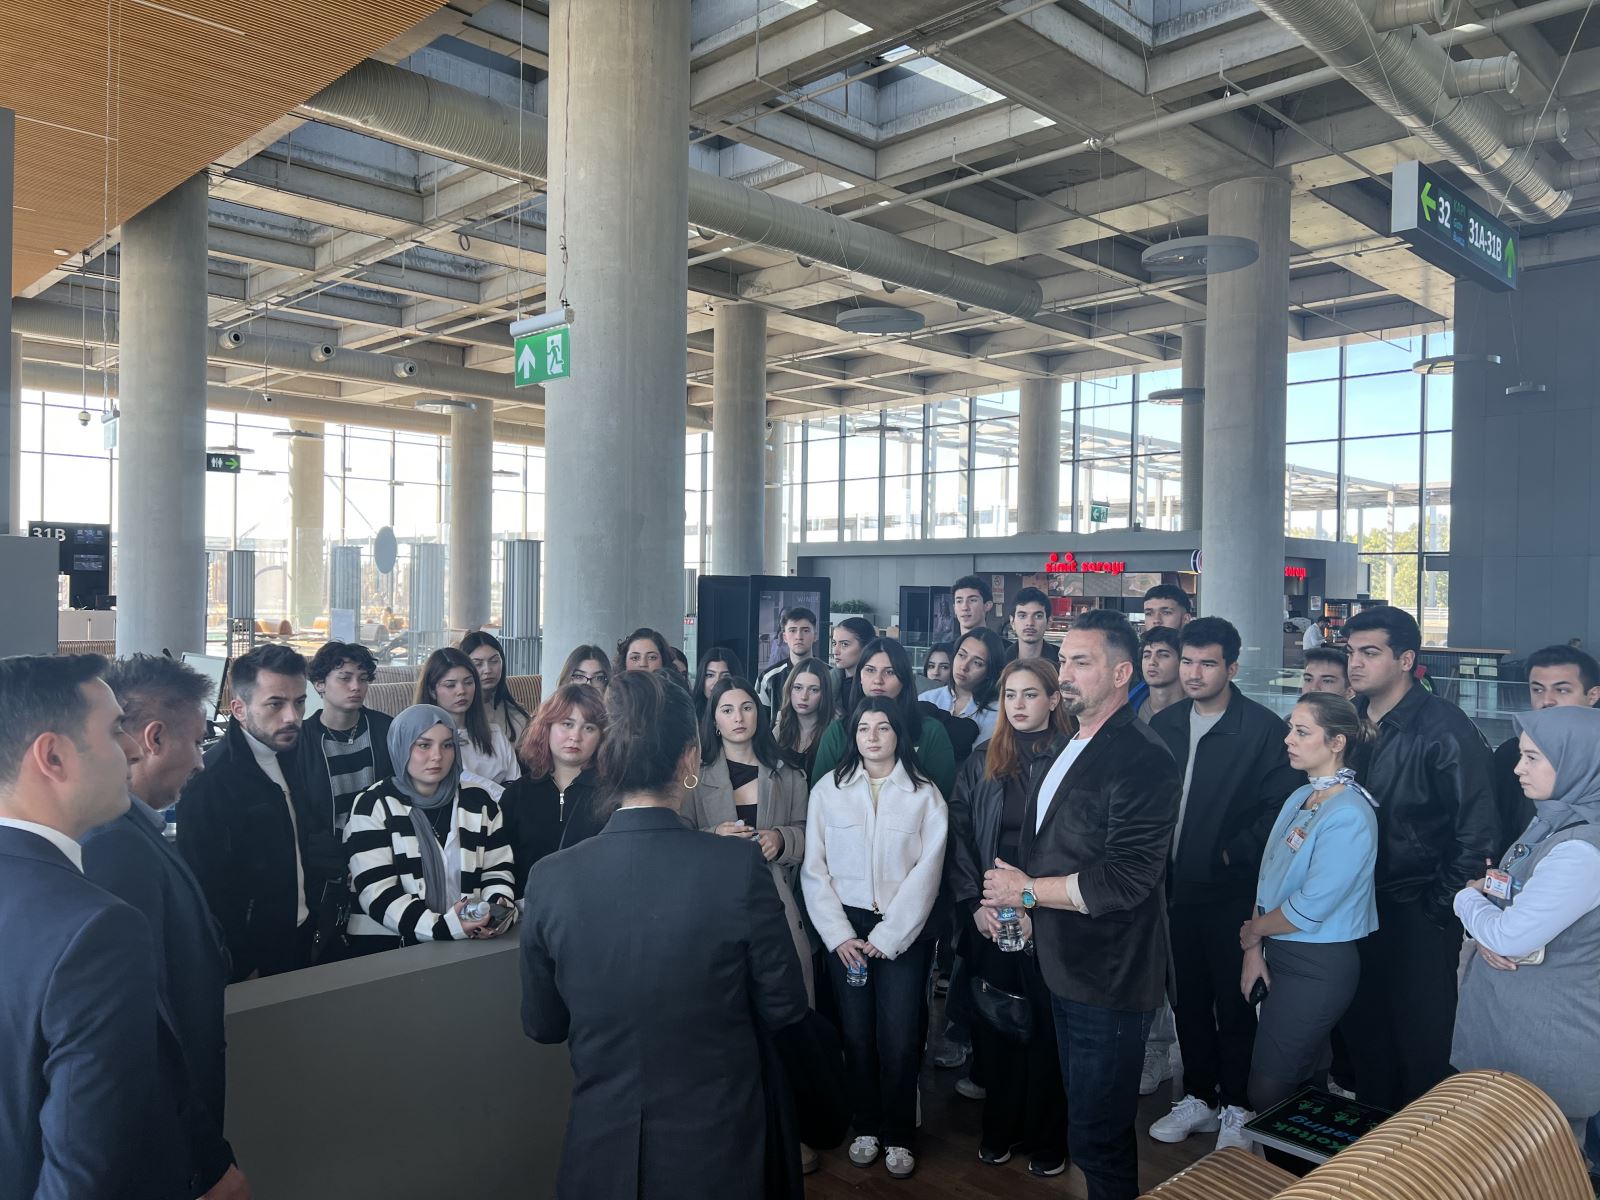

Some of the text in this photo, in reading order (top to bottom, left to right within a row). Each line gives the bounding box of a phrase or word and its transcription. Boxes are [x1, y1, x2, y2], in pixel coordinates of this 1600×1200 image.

[1438, 196, 1451, 229] 32
[1469, 218, 1502, 262] 31A-31B
[32, 527, 66, 542] 31B
[1288, 1115, 1360, 1142] eating
